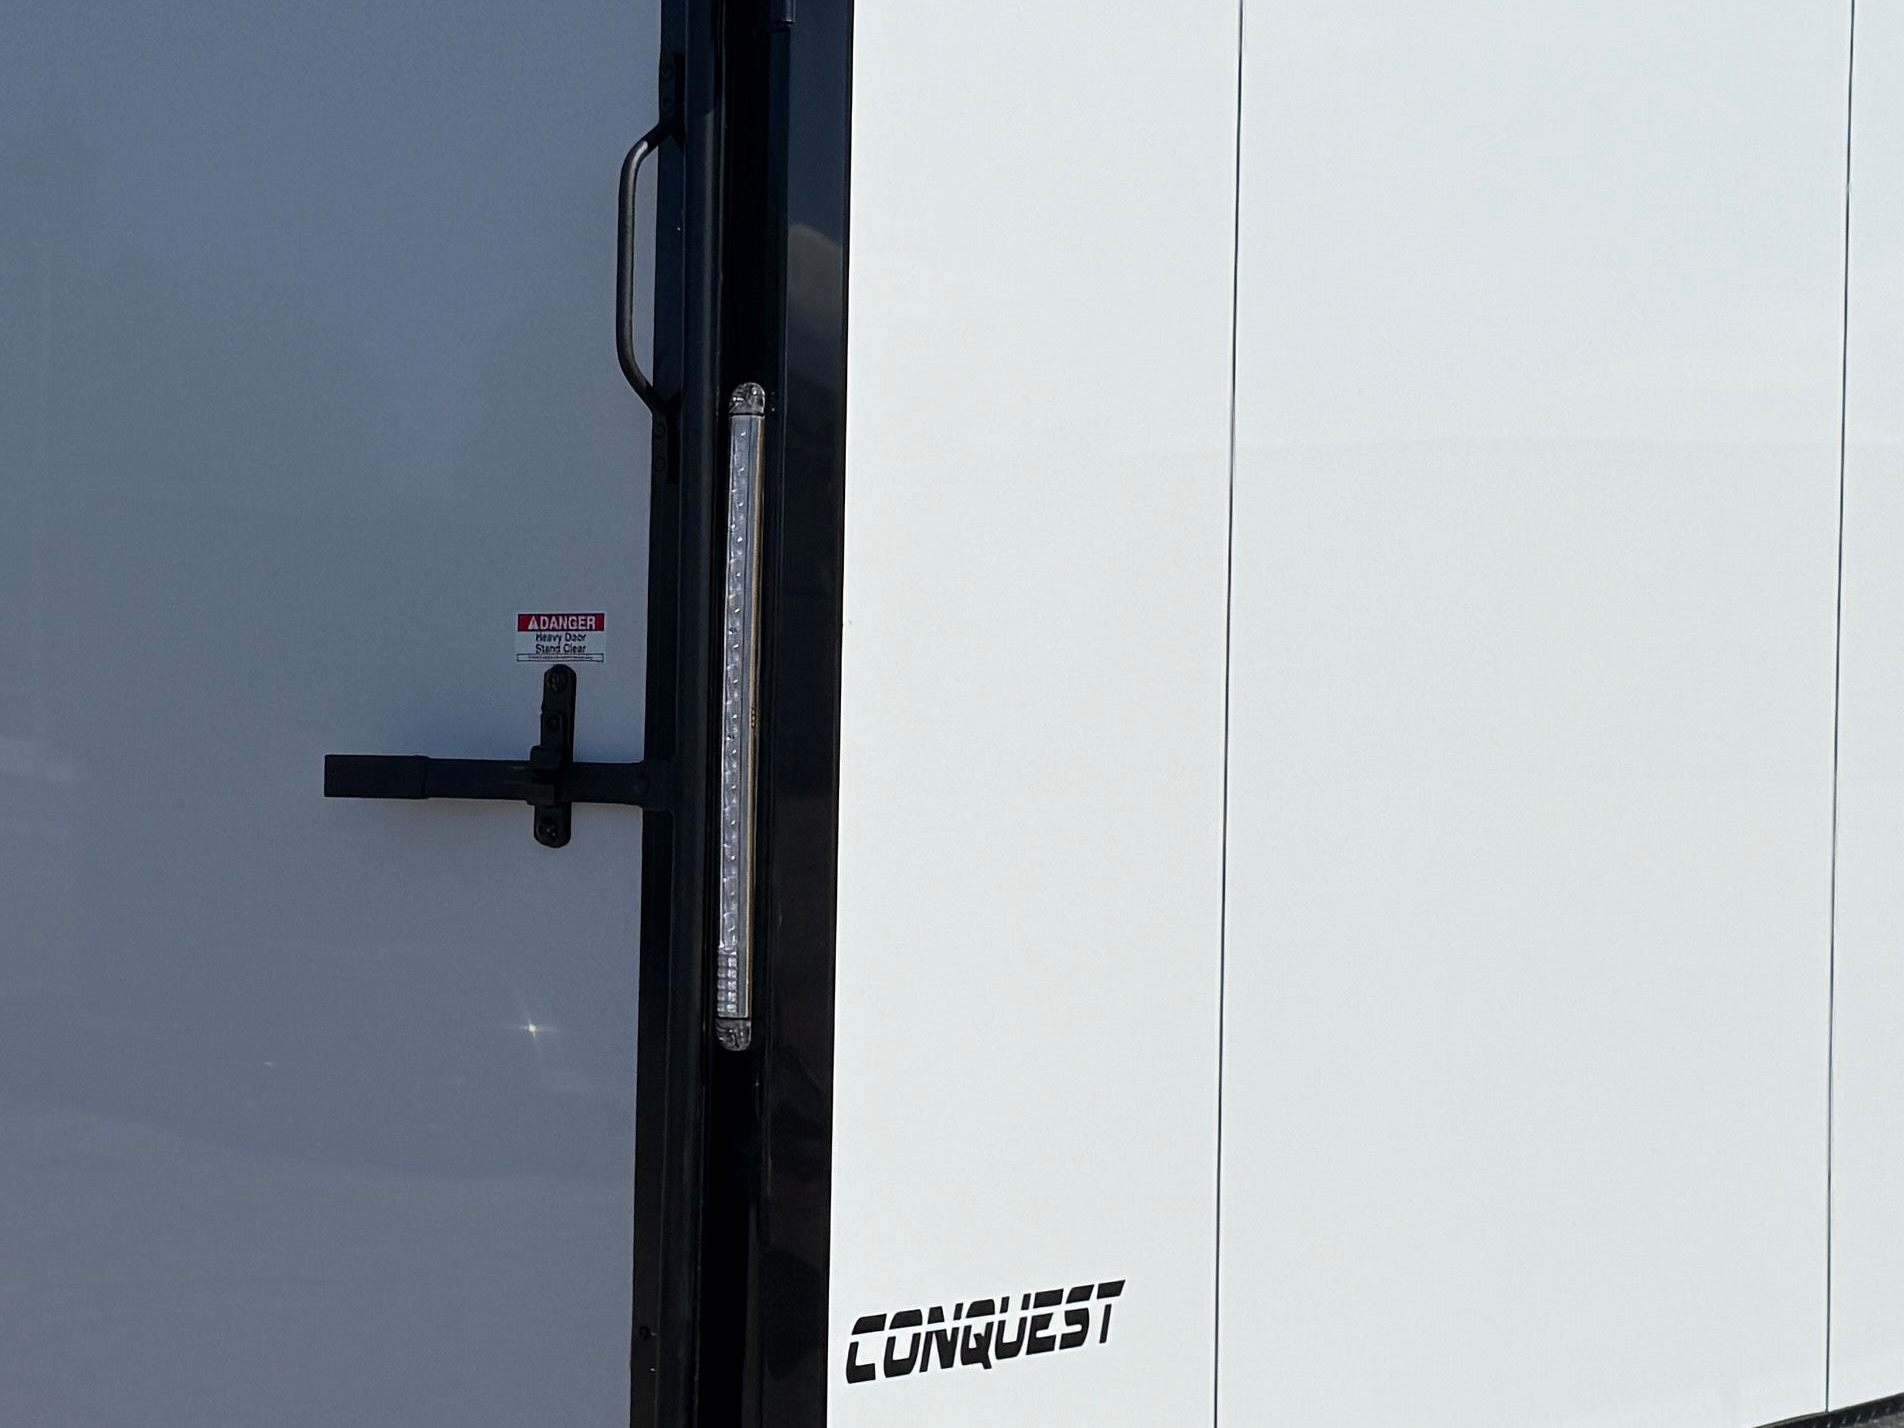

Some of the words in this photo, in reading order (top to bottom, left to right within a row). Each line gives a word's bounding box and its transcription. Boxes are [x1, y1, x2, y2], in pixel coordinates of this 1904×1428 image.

[540, 615, 596, 630] DANGER
[536, 632, 562, 644] Heavy
[563, 643, 586, 654] Clear
[846, 1279, 1126, 1384] CONQUEST
